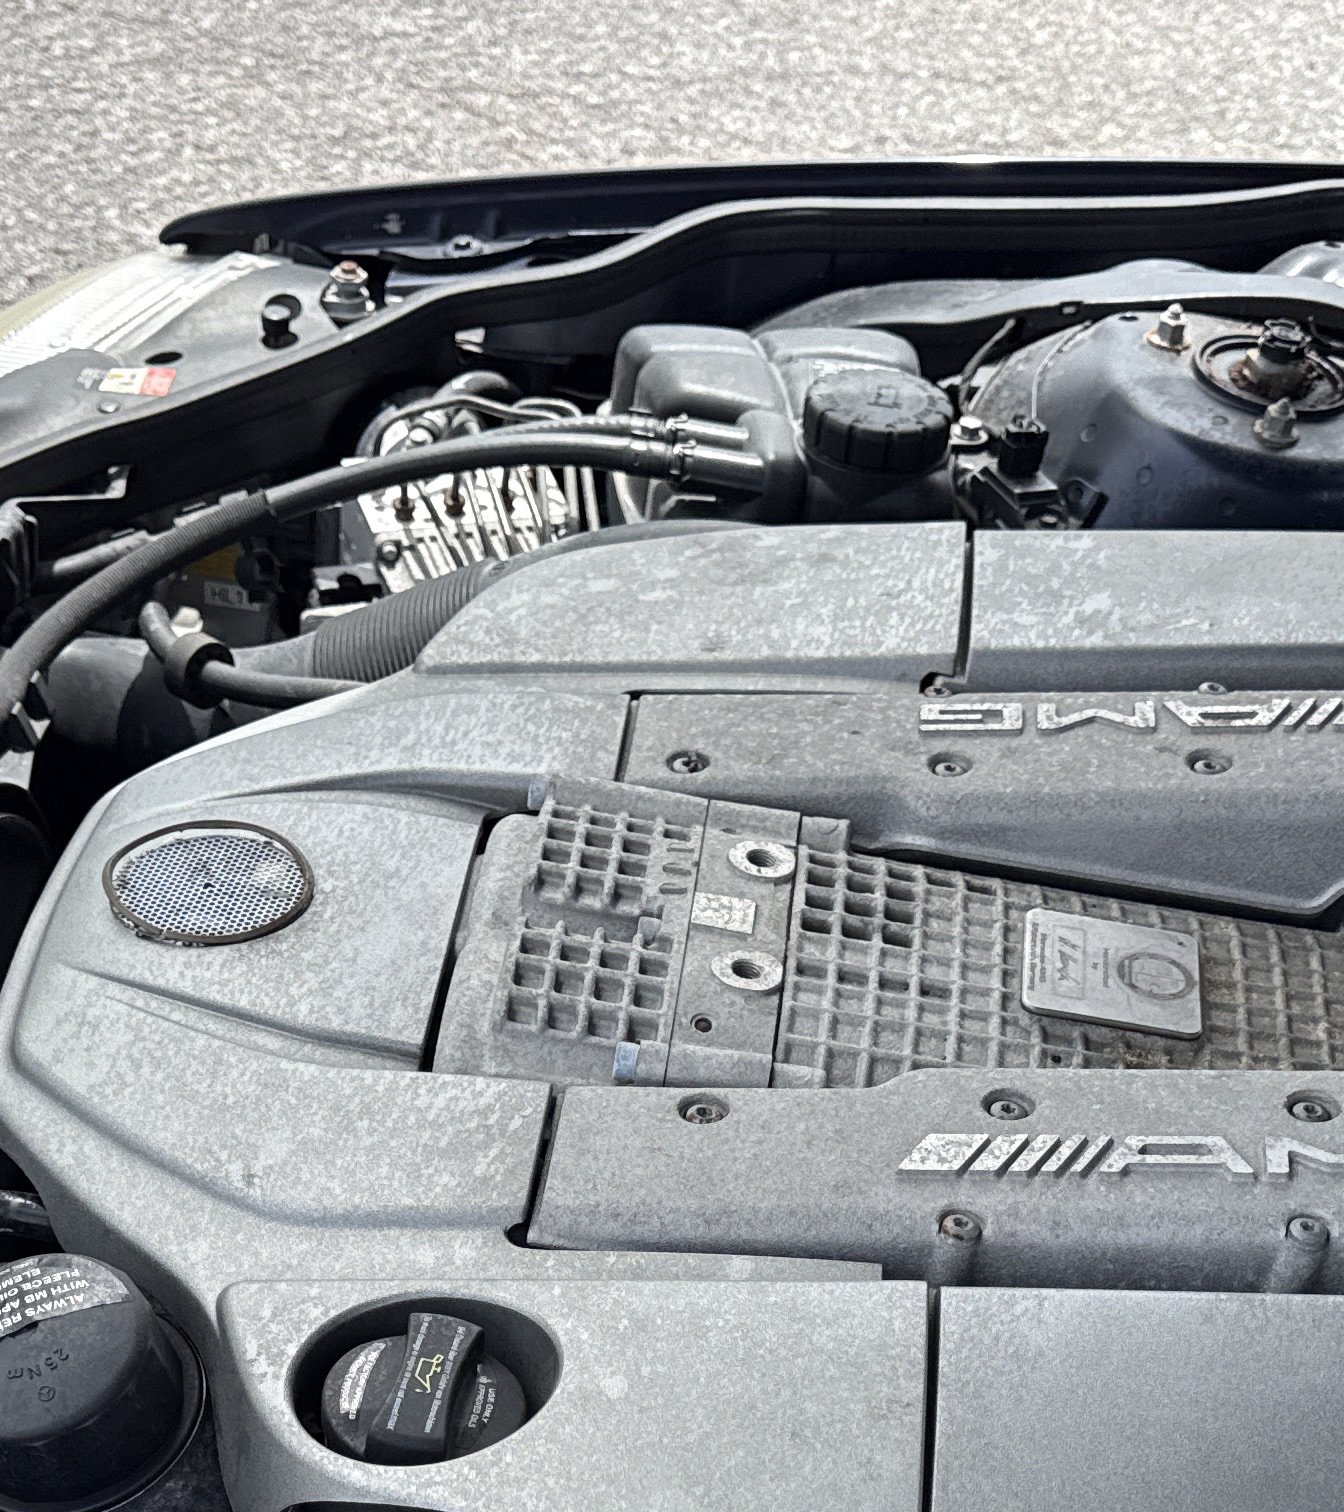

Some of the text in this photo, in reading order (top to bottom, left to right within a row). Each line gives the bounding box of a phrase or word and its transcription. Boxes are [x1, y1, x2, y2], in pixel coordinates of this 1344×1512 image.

[919, 698, 1294, 731] AMG
[22, 1268, 81, 1291] FLEECE
[50, 1279, 91, 1298] WITH
[0, 1288, 20, 1302] OIL
[22, 1289, 48, 1304] MB
[25, 1293, 86, 1317] ALWAYS
